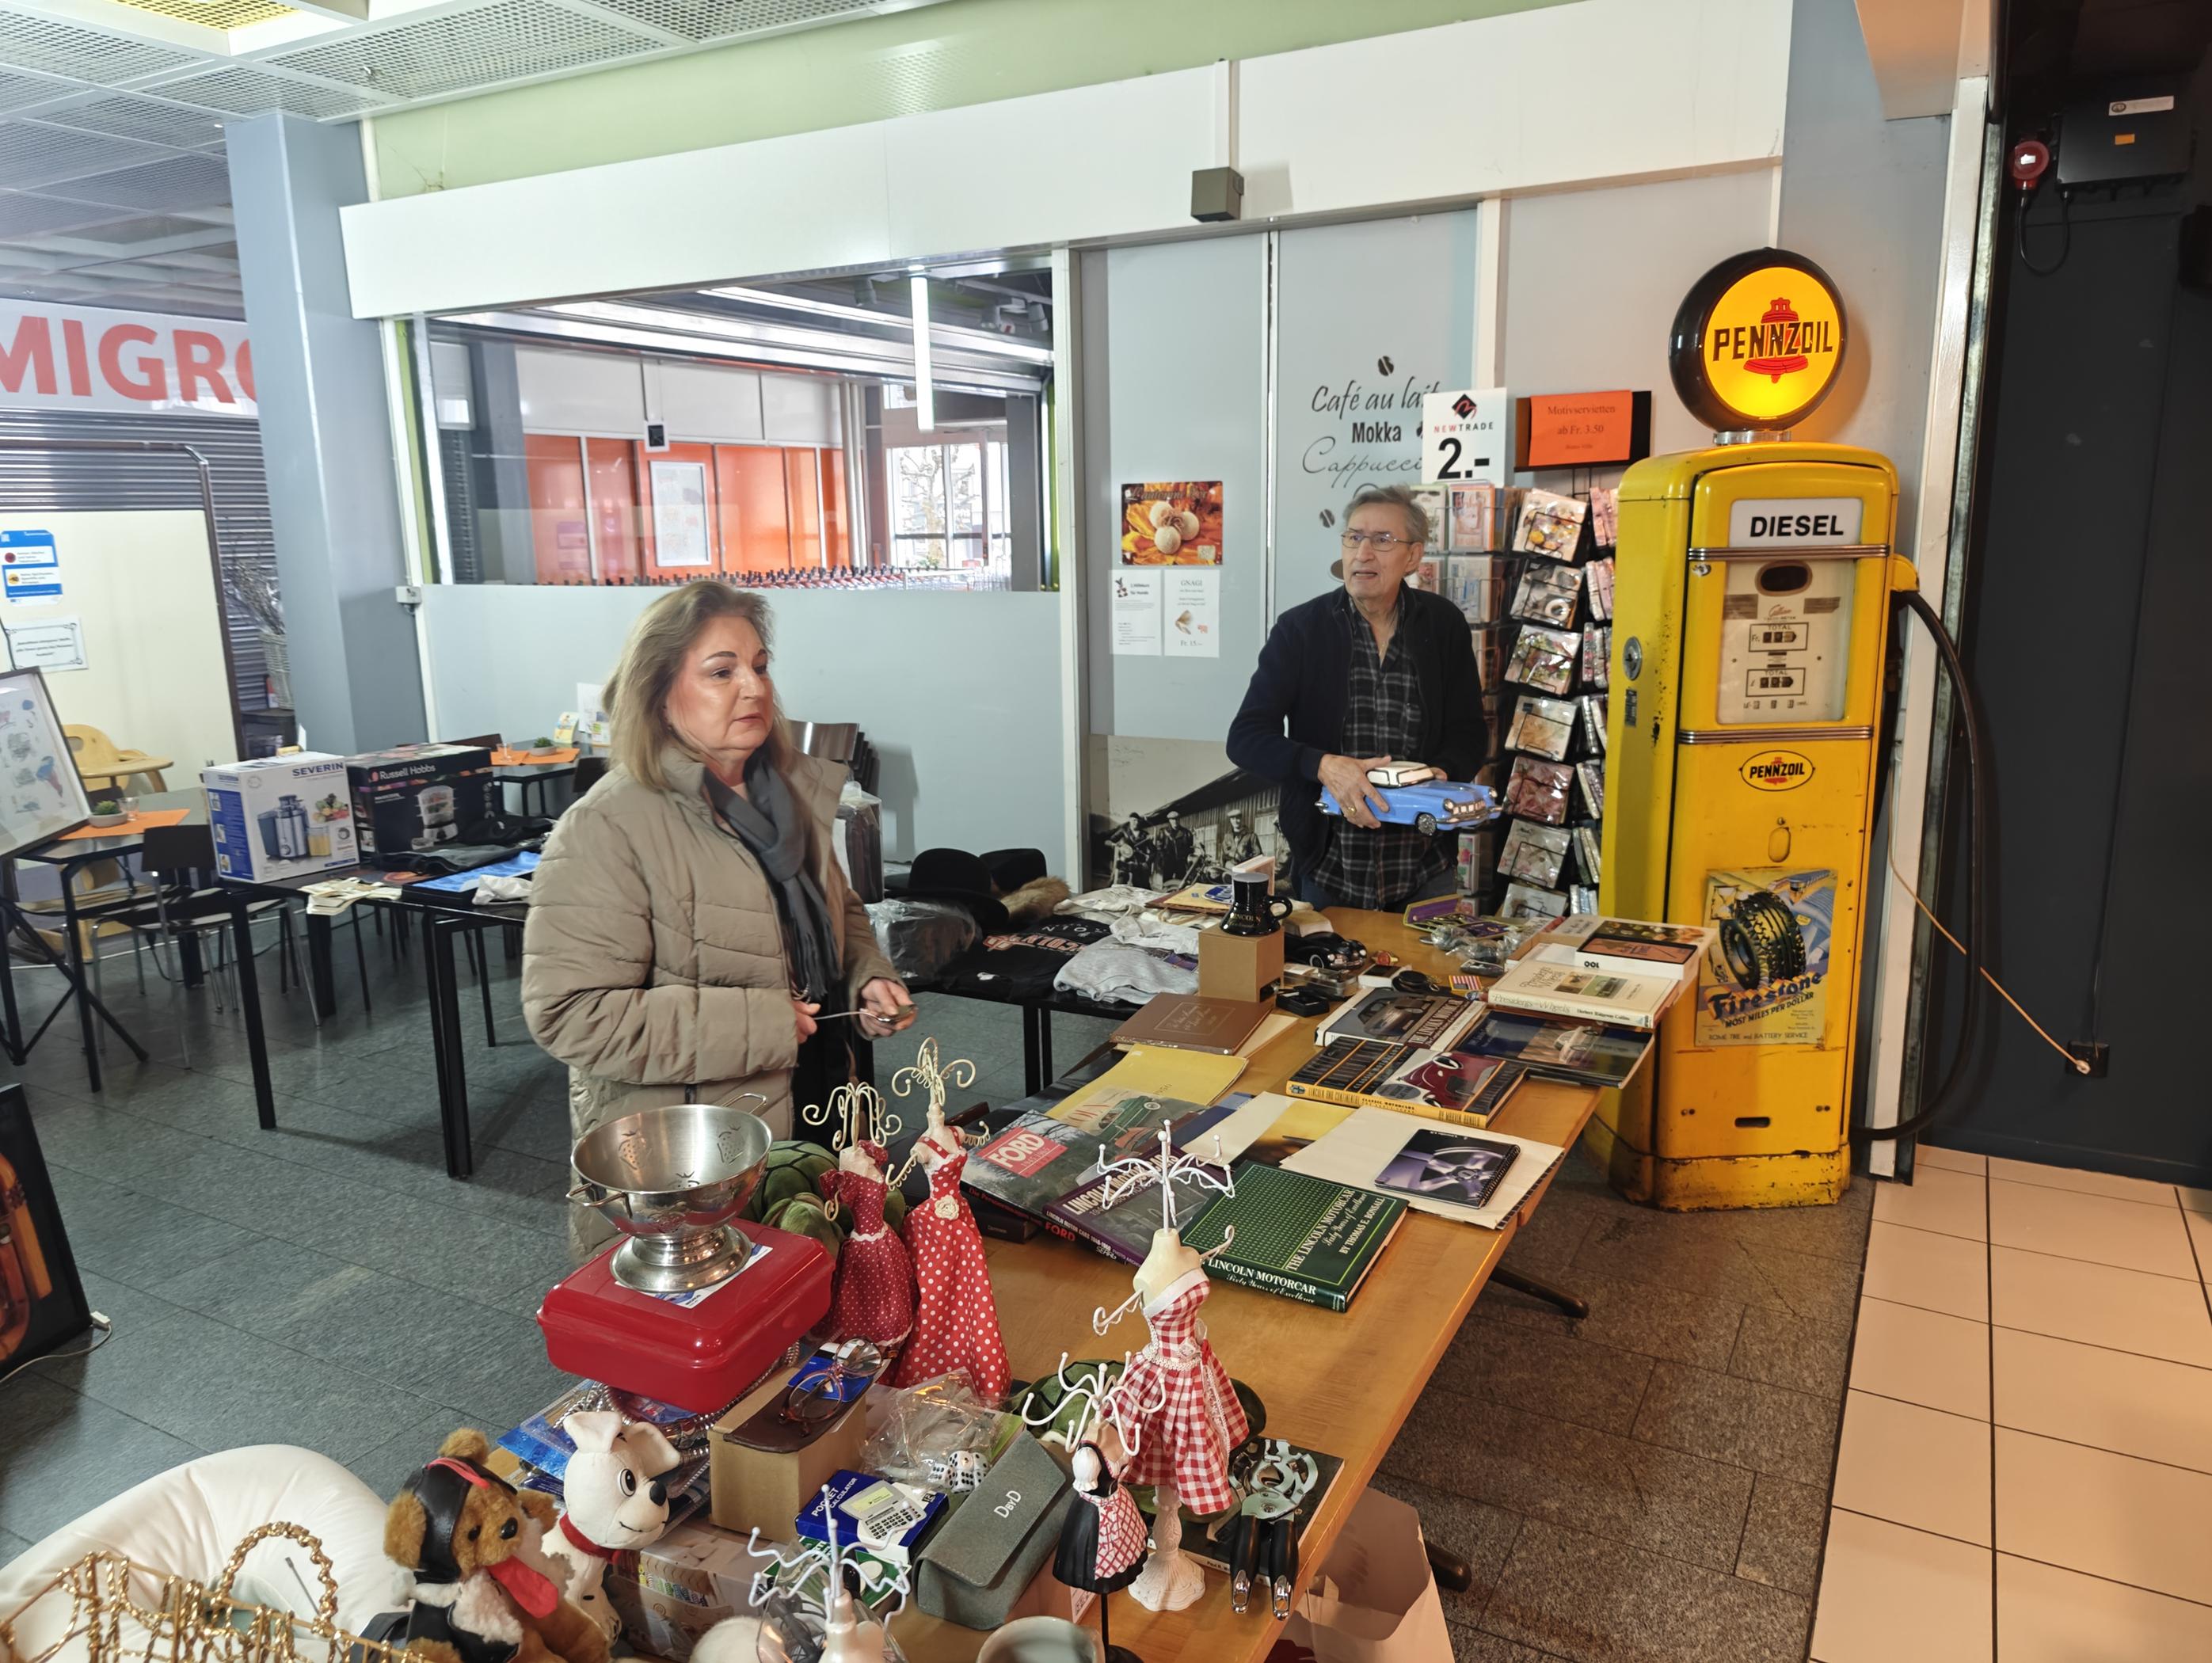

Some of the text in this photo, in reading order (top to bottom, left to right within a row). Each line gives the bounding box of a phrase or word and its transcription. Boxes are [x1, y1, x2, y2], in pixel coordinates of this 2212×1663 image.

[1712, 320, 1833, 362] PENNZOIL
[0, 314, 257, 405] MIGR
[1312, 380, 1361, 420] Café
[1365, 392, 1394, 409] au
[1352, 421, 1401, 443] Mokka
[1433, 421, 1494, 433] NEWTRADE
[1557, 424, 1605, 435] ab Fr. 3.50
[1750, 515, 1845, 538] DIESEL
[292, 762, 344, 777] SEVERIN
[380, 764, 436, 780] Russell Hobbs
[1749, 763, 1805, 779] PENNZOIL
[1706, 971, 1822, 1020] Firestone
[1725, 1016, 1747, 1028] MOST
[1748, 1010, 1769, 1022] MILES
[1771, 1004, 1785, 1014] PER
[1787, 991, 1814, 1008] DOLLAR
[988, 1133, 1046, 1169] FORD
[1045, 1221, 1076, 1242] FORD
[1285, 1189, 1356, 1271] THE LINCOLN MOTORCAR
[1338, 1246, 1350, 1254] BY
[1346, 1223, 1366, 1246] THOMAS
[1365, 1197, 1385, 1220] BONSALL
[1208, 1258, 1317, 1296] LINCOLN MOTORCAR
[1226, 1273, 1247, 1286] Sixty
[1270, 1286, 1278, 1295] of
[811, 1487, 839, 1517] POCET
[829, 1477, 858, 1509] CALCULATOR
